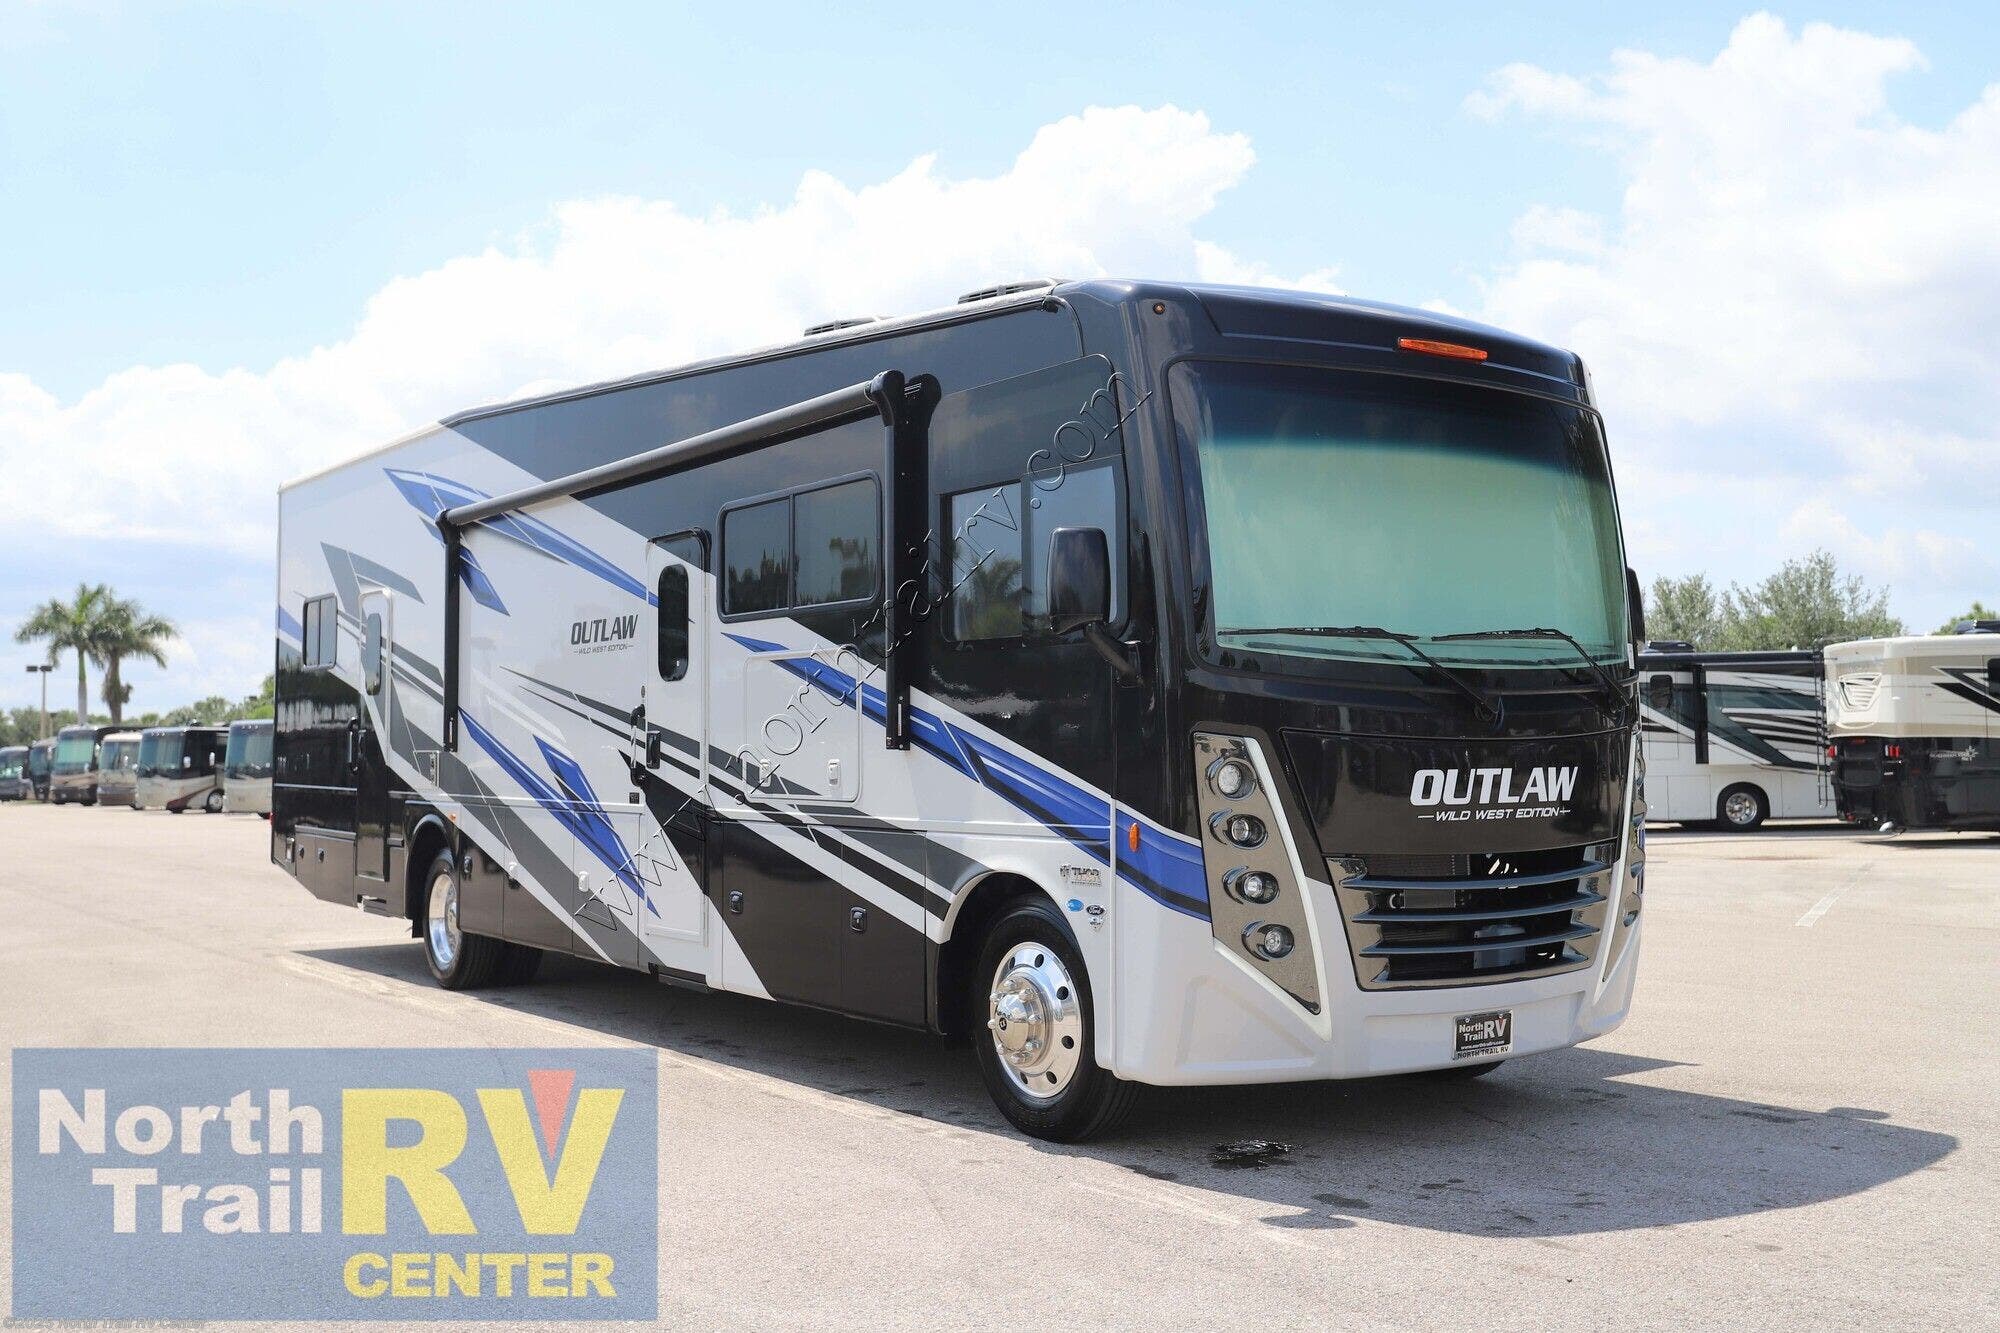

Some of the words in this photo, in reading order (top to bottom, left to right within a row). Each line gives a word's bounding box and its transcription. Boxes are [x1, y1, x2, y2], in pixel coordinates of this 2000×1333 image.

[570, 614, 639, 645] OUTLAW
[1410, 766, 1578, 806] OUTLAW
[1435, 810, 1471, 821] WILD
[1475, 808, 1513, 820] WEST
[1515, 806, 1559, 819] EDITION
[1459, 1022, 1483, 1033] North
[1483, 1018, 1507, 1039] RV
[1463, 1031, 1483, 1042] Trail
[1457, 1050, 1480, 1059] NORTH
[1480, 1048, 1500, 1056] TRAIL
